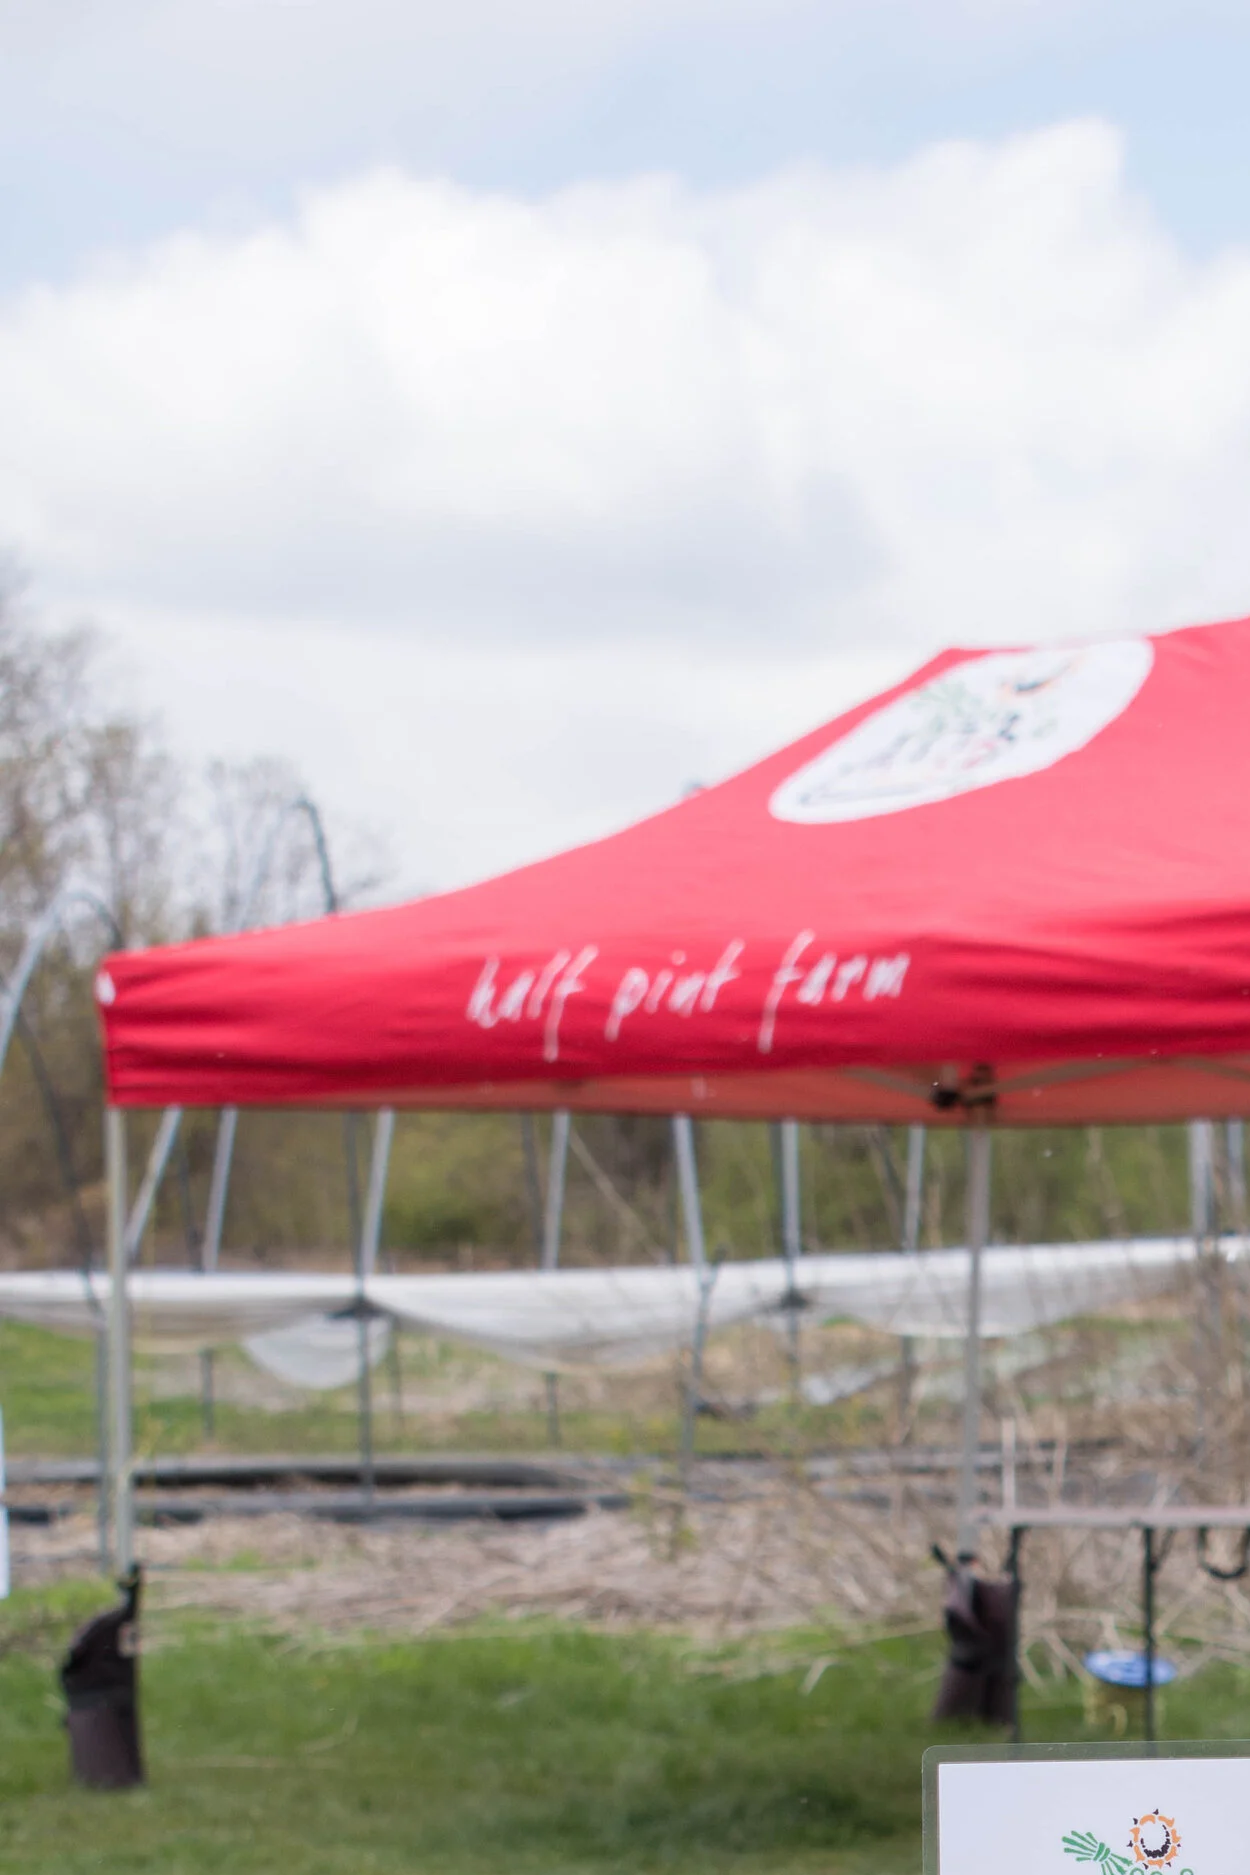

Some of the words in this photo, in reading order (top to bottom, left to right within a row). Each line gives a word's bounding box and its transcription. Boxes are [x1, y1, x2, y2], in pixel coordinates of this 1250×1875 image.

[467, 944, 598, 1062] half
[604, 937, 744, 1042] pint
[757, 929, 911, 1054] farm
